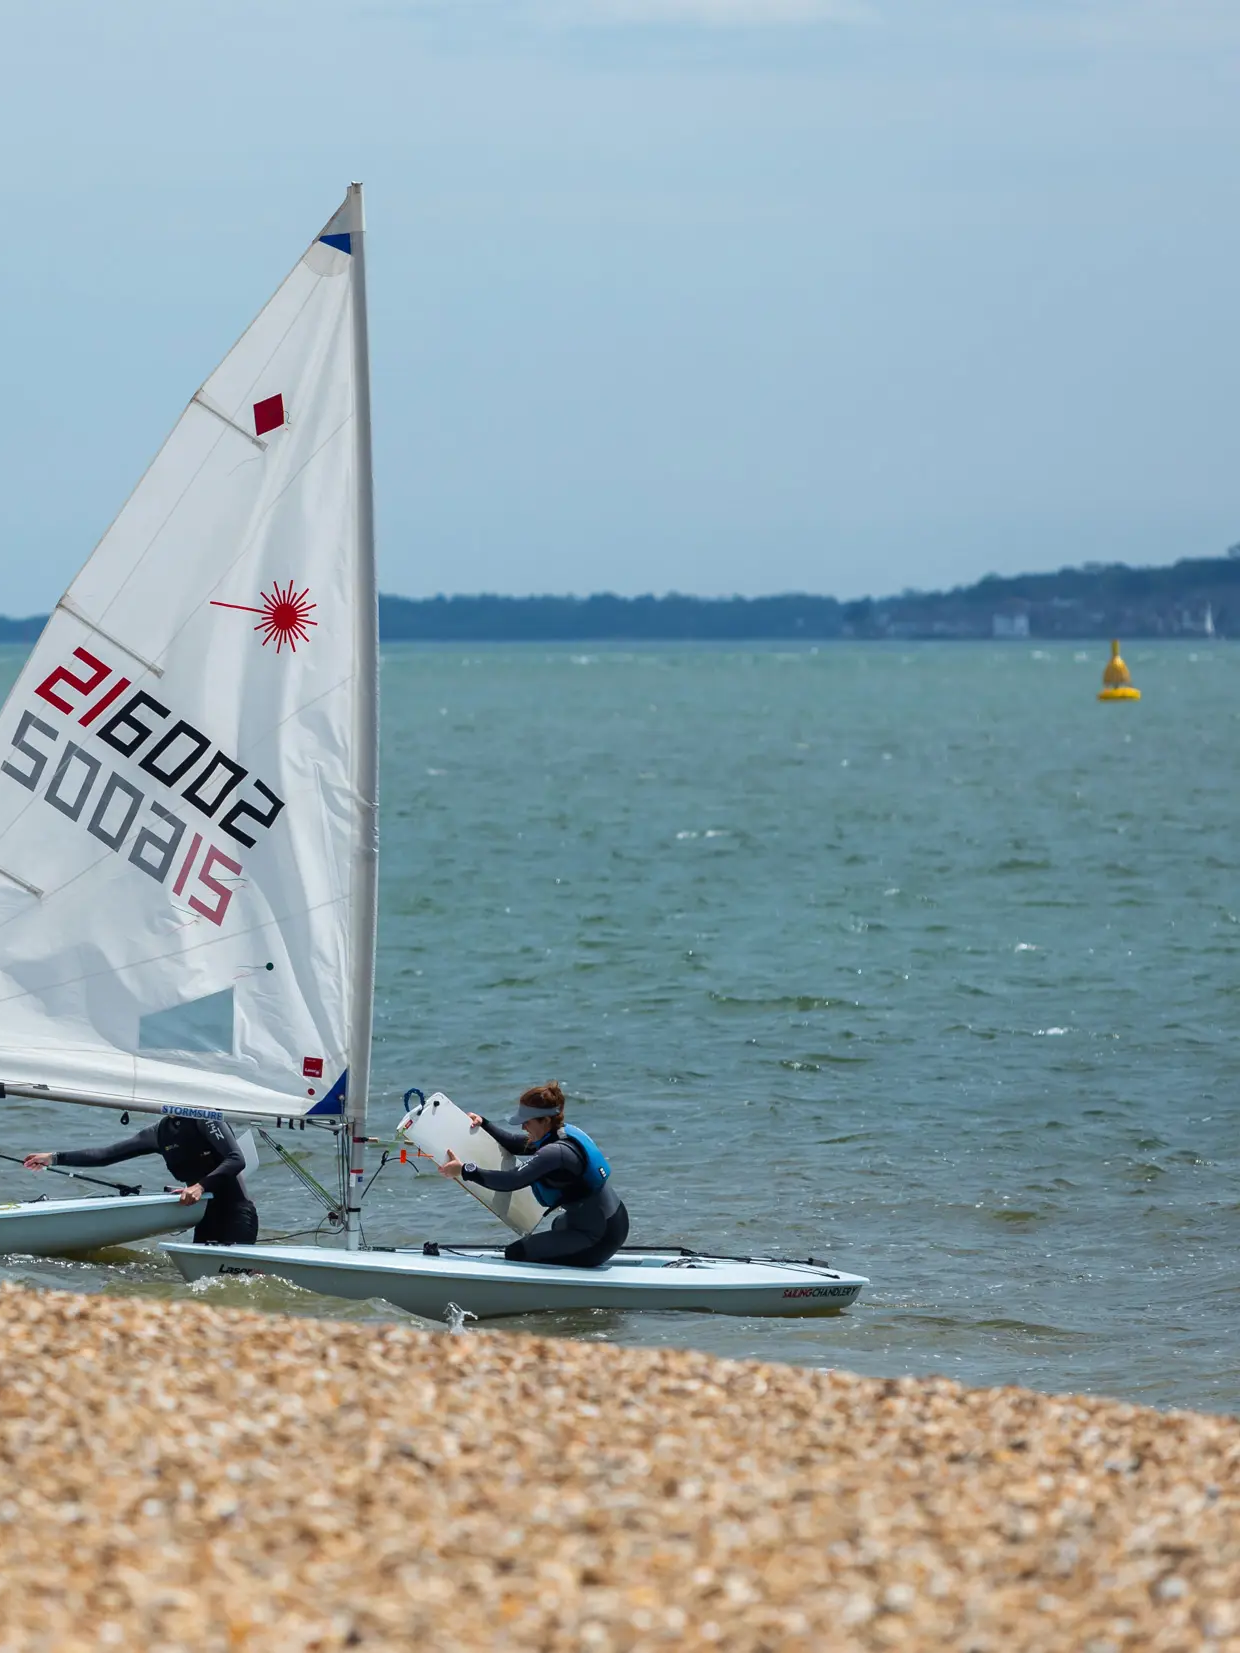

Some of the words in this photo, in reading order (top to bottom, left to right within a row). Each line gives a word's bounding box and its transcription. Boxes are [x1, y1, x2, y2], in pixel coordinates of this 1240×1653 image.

[34, 646, 285, 849] 216002
[162, 1105, 223, 1120] STORMSURE
[218, 1264, 253, 1275] Laser
